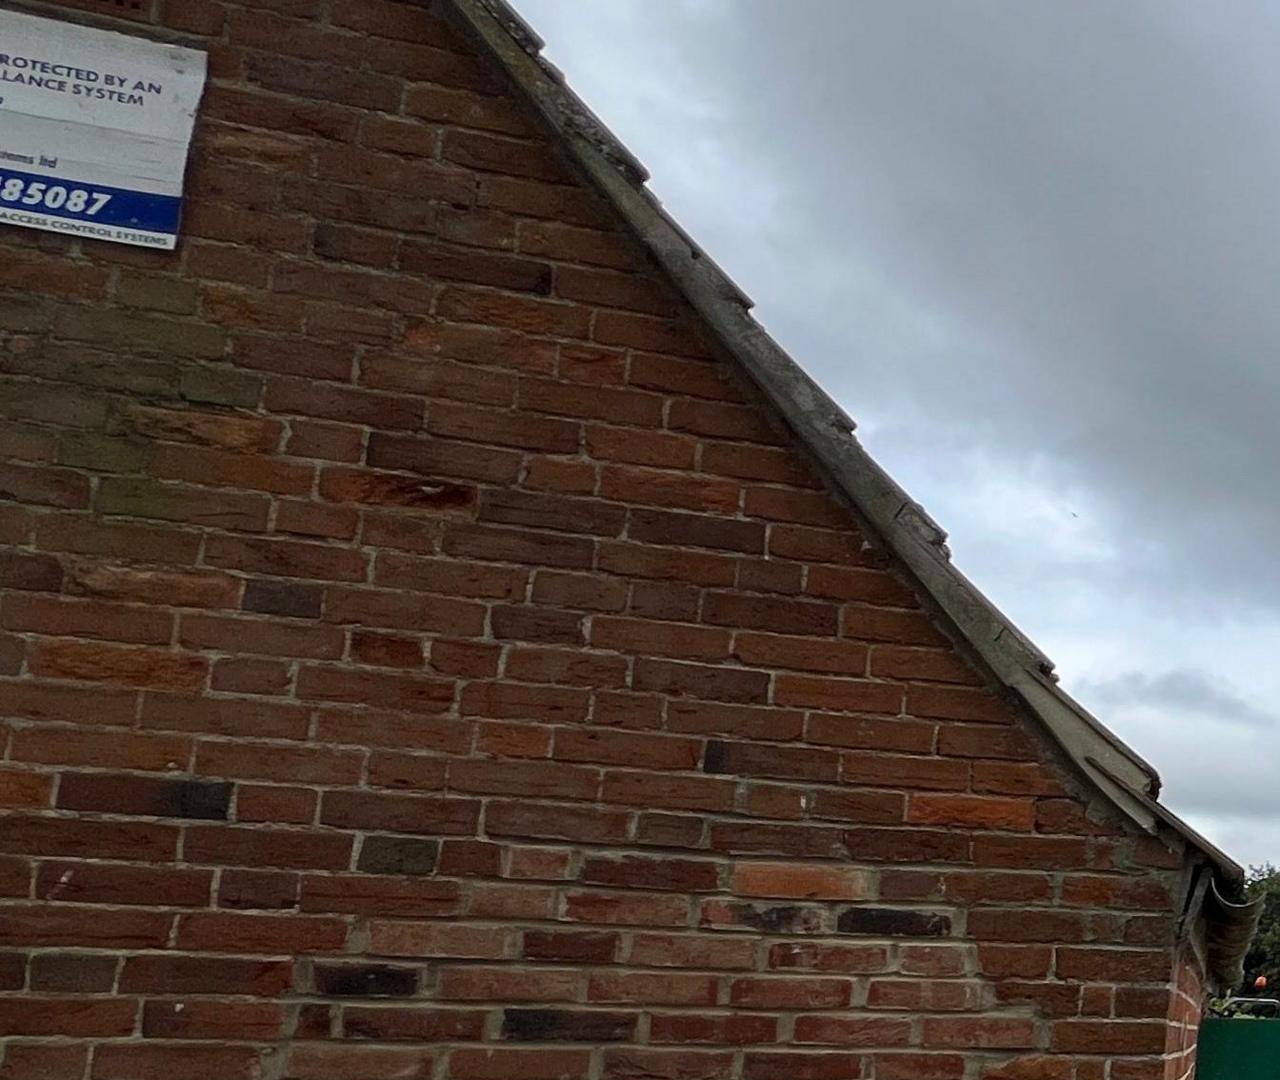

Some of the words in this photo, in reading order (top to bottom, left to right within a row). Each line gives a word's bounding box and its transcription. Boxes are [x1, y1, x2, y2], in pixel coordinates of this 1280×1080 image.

[0, 69, 68, 93] LANCE
[71, 83, 145, 107] SYSTEM
[104, 73, 128, 88] BY
[132, 80, 163, 95] AN
[0, 176, 112, 215] 85087
[51, 221, 112, 238] CONTROL
[115, 231, 168, 246] SYSTEMS
